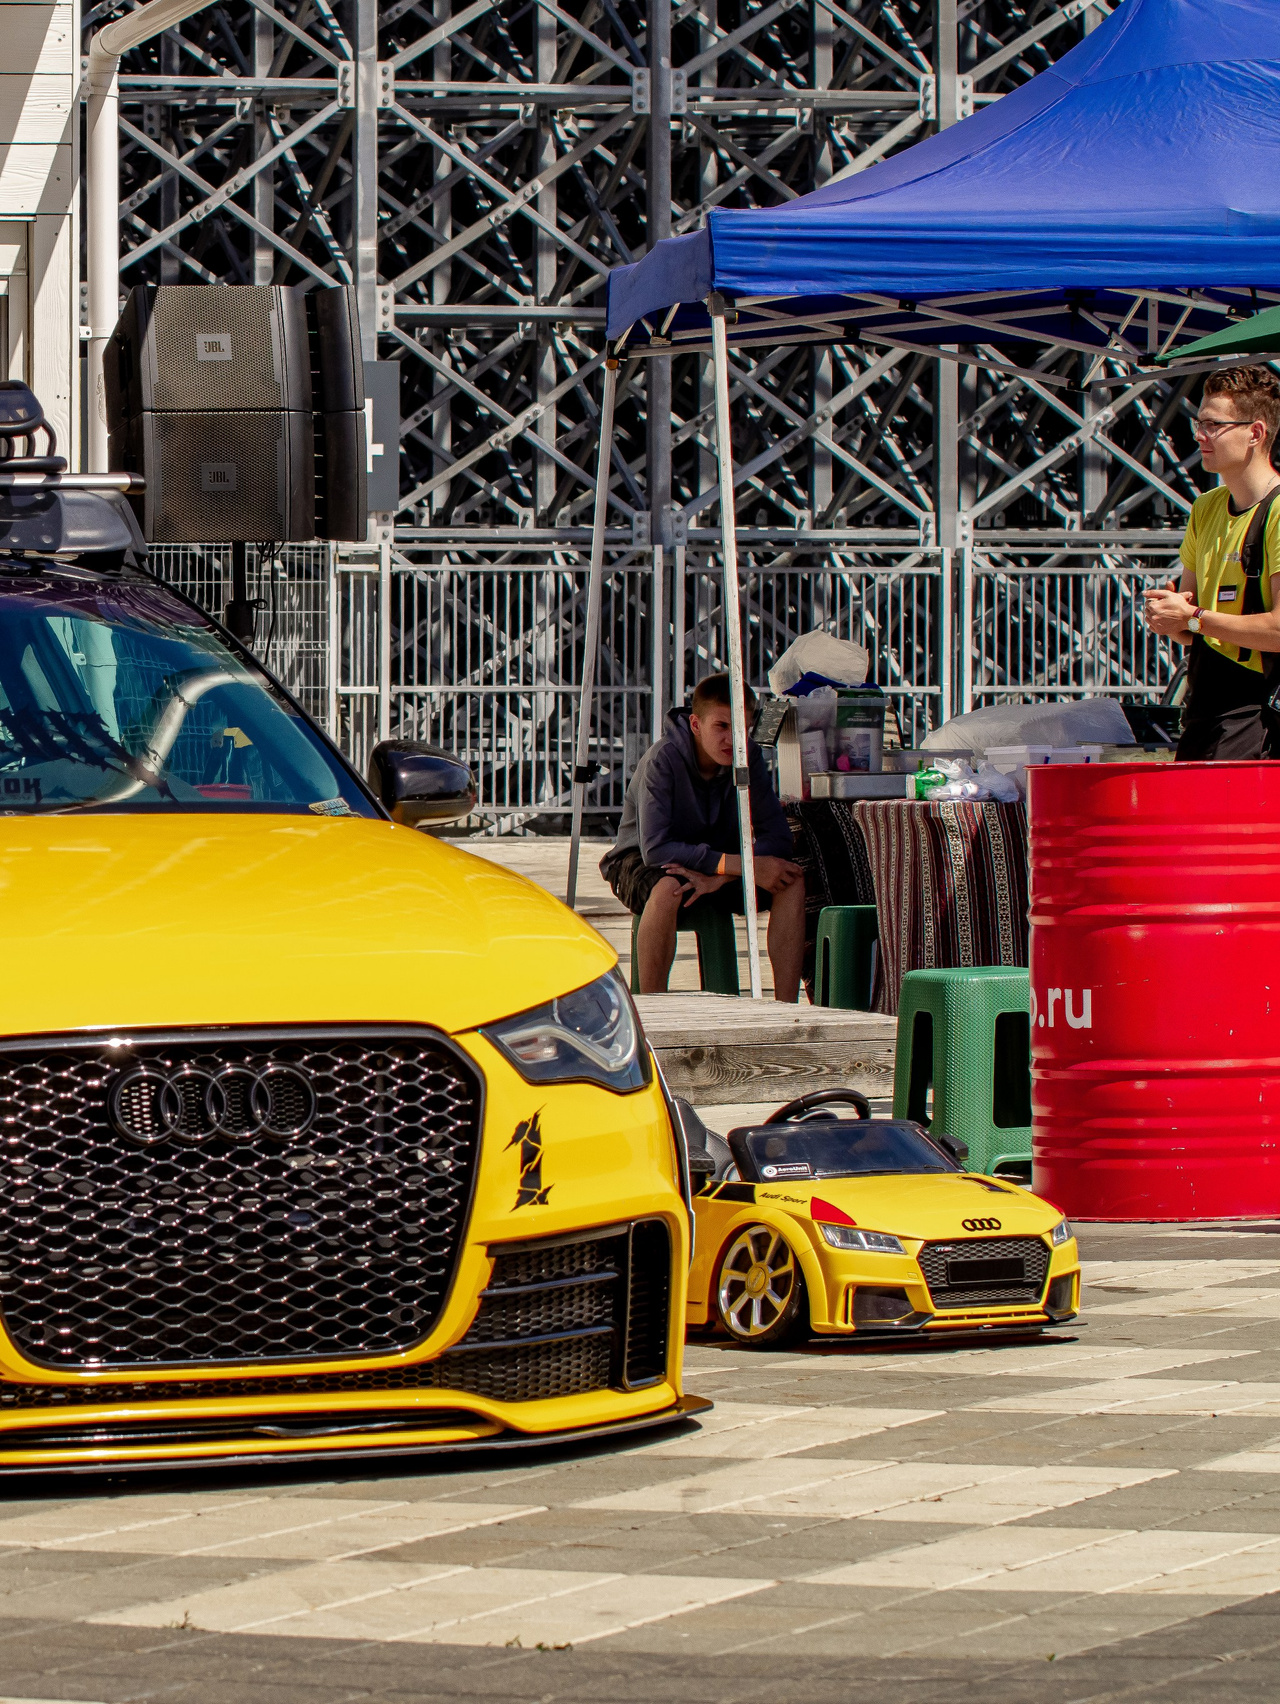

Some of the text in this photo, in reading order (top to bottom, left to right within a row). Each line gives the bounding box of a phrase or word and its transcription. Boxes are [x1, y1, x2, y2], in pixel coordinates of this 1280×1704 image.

[204, 340, 225, 353] JBL
[208, 471, 230, 483] JBL
[759, 1192, 808, 1205] Audi Sport
